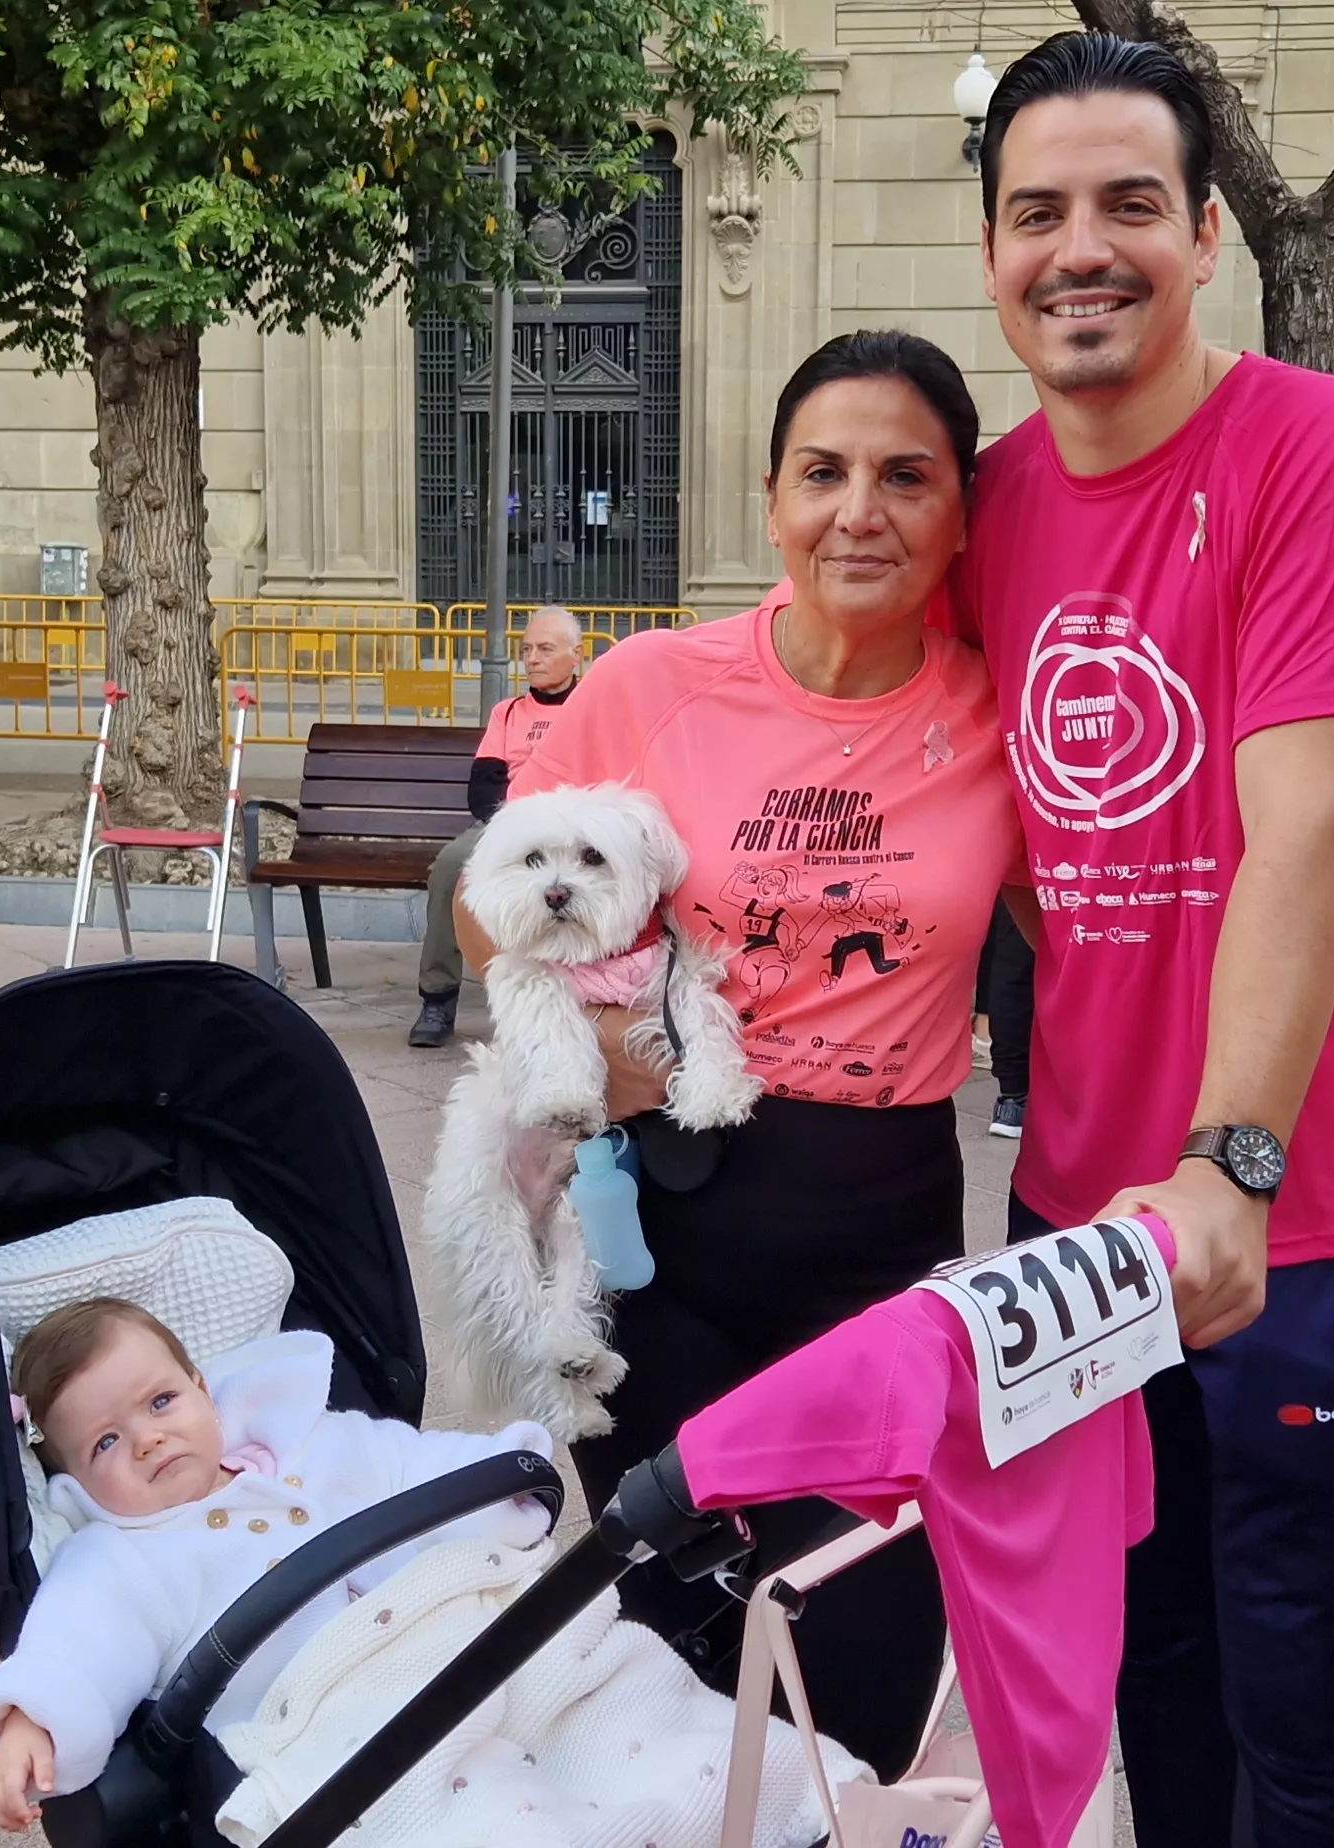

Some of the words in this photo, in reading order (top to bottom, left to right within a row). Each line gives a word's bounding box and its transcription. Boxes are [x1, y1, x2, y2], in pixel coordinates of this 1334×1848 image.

[1089, 625, 1103, 635] EL
[760, 786, 873, 823] CORRAMOS
[730, 818, 776, 852] POR
[776, 820, 801, 851] LA
[805, 813, 885, 851] CIENCIA
[811, 854, 837, 866] Carrera
[838, 854, 861, 865] Huesca
[862, 853, 884, 865] contra
[1149, 860, 1190, 873] URBAN
[747, 918, 763, 933] 19
[790, 1058, 832, 1070] URBAN
[969, 1222, 1151, 1368] 3114
